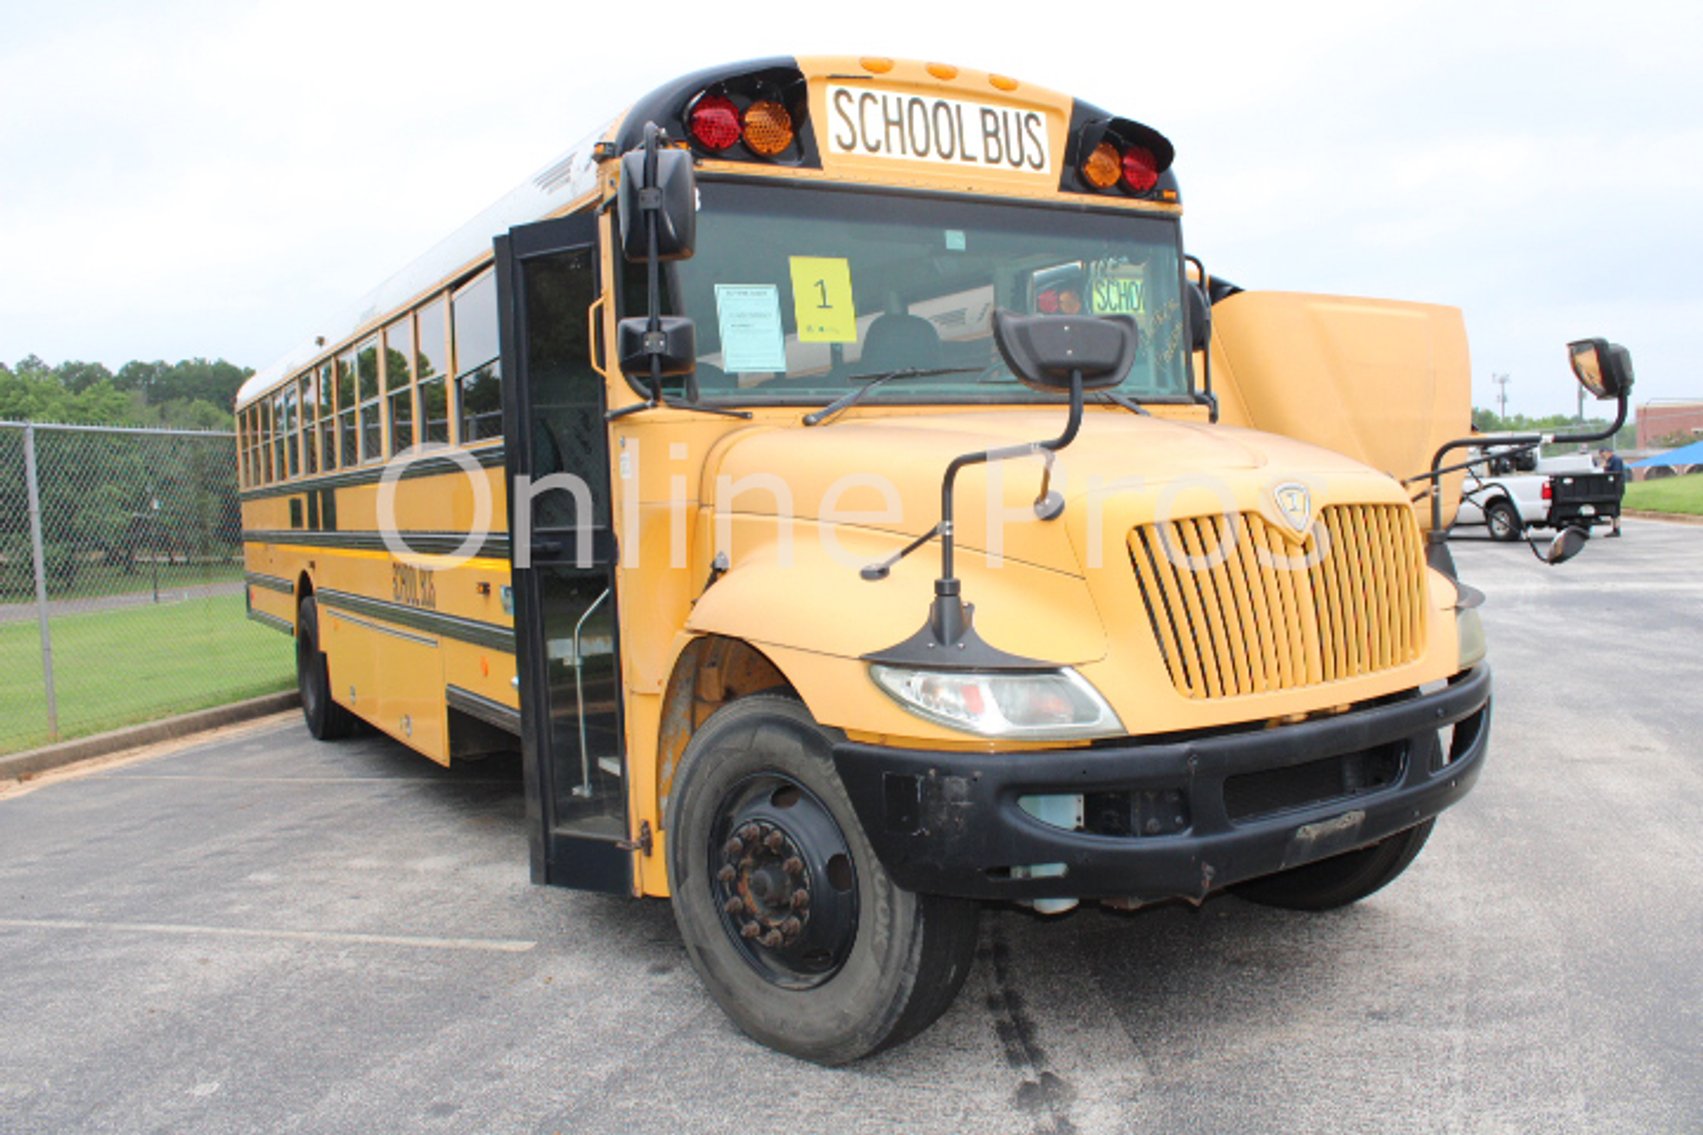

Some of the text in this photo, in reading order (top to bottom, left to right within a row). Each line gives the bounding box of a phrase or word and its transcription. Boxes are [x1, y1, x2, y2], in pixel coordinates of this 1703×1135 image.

[833, 88, 1045, 171] SCHOOL BUS
[813, 278, 834, 310] 1
[1096, 280, 1146, 311] SCHO
